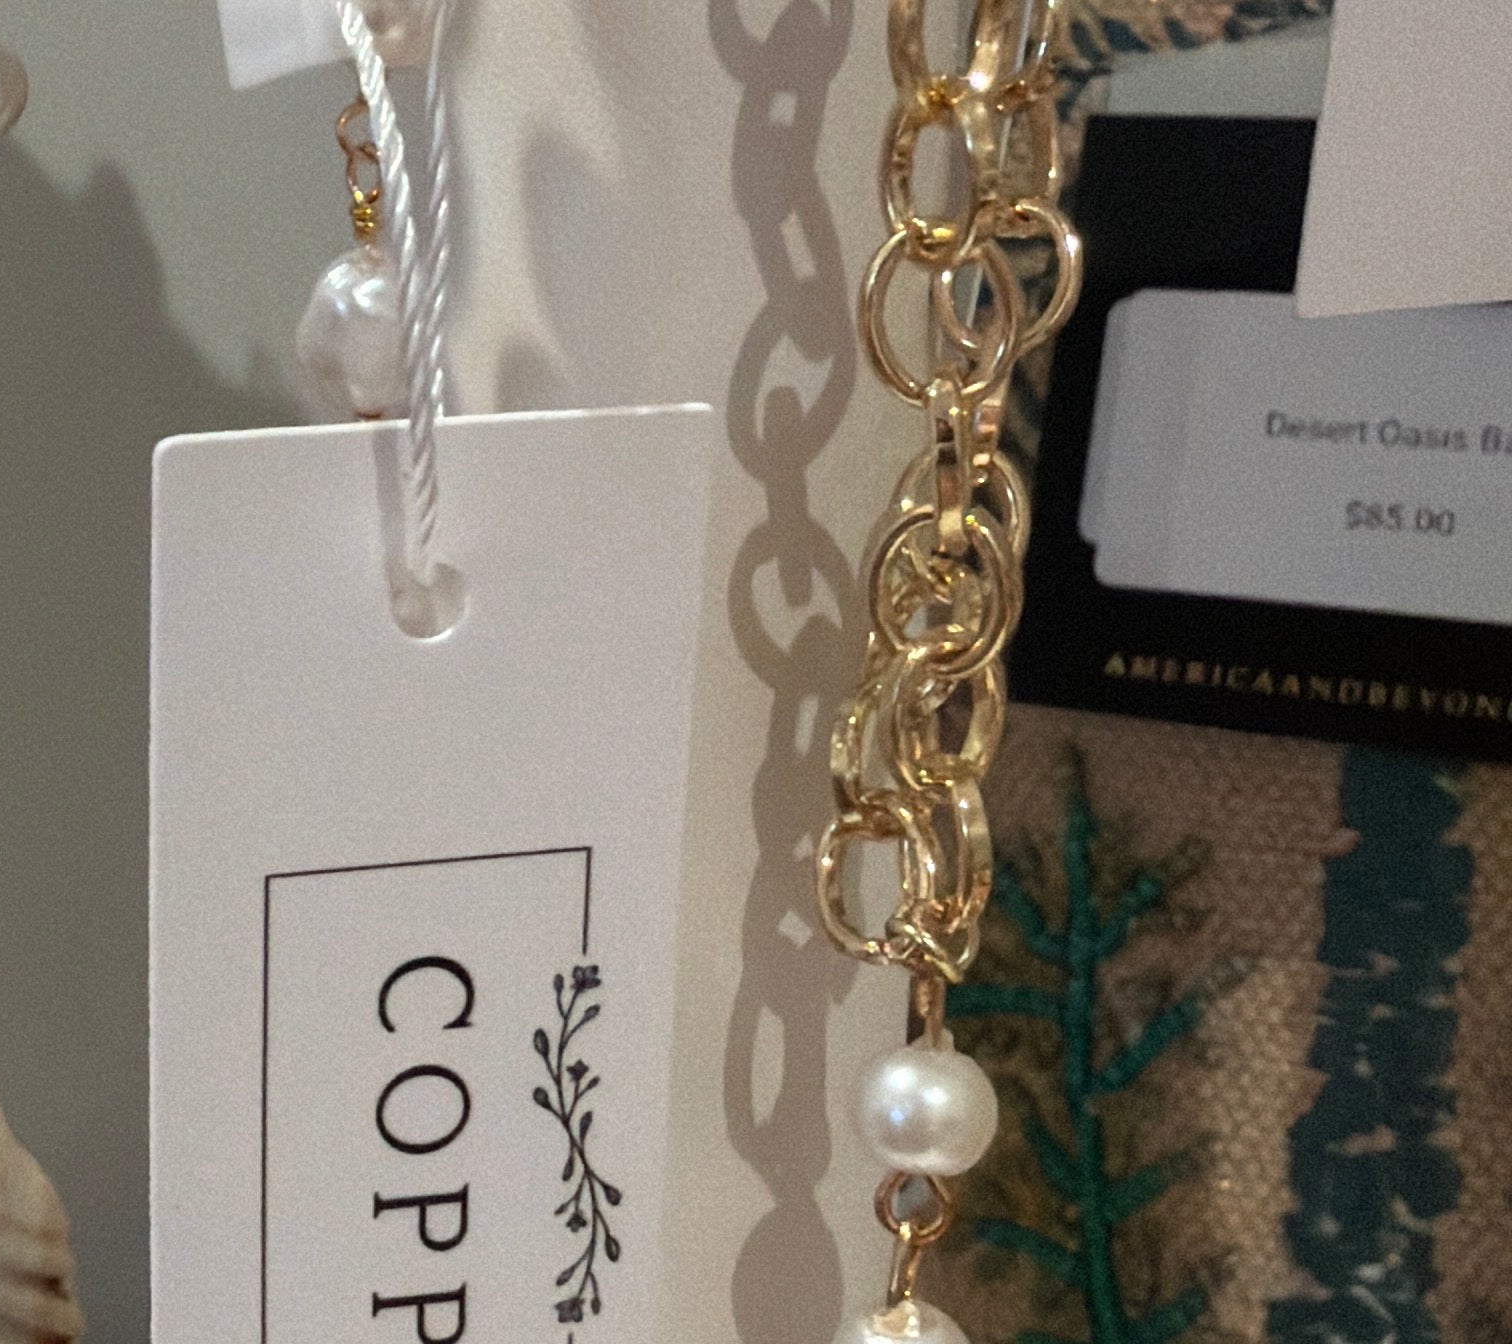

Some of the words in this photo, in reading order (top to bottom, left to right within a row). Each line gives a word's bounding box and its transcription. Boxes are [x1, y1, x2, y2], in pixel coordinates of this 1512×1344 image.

[1264, 410, 1367, 446] Desert
[1377, 417, 1469, 452] Oasis
[1103, 651, 1512, 722] AMERICAANDBEYON
